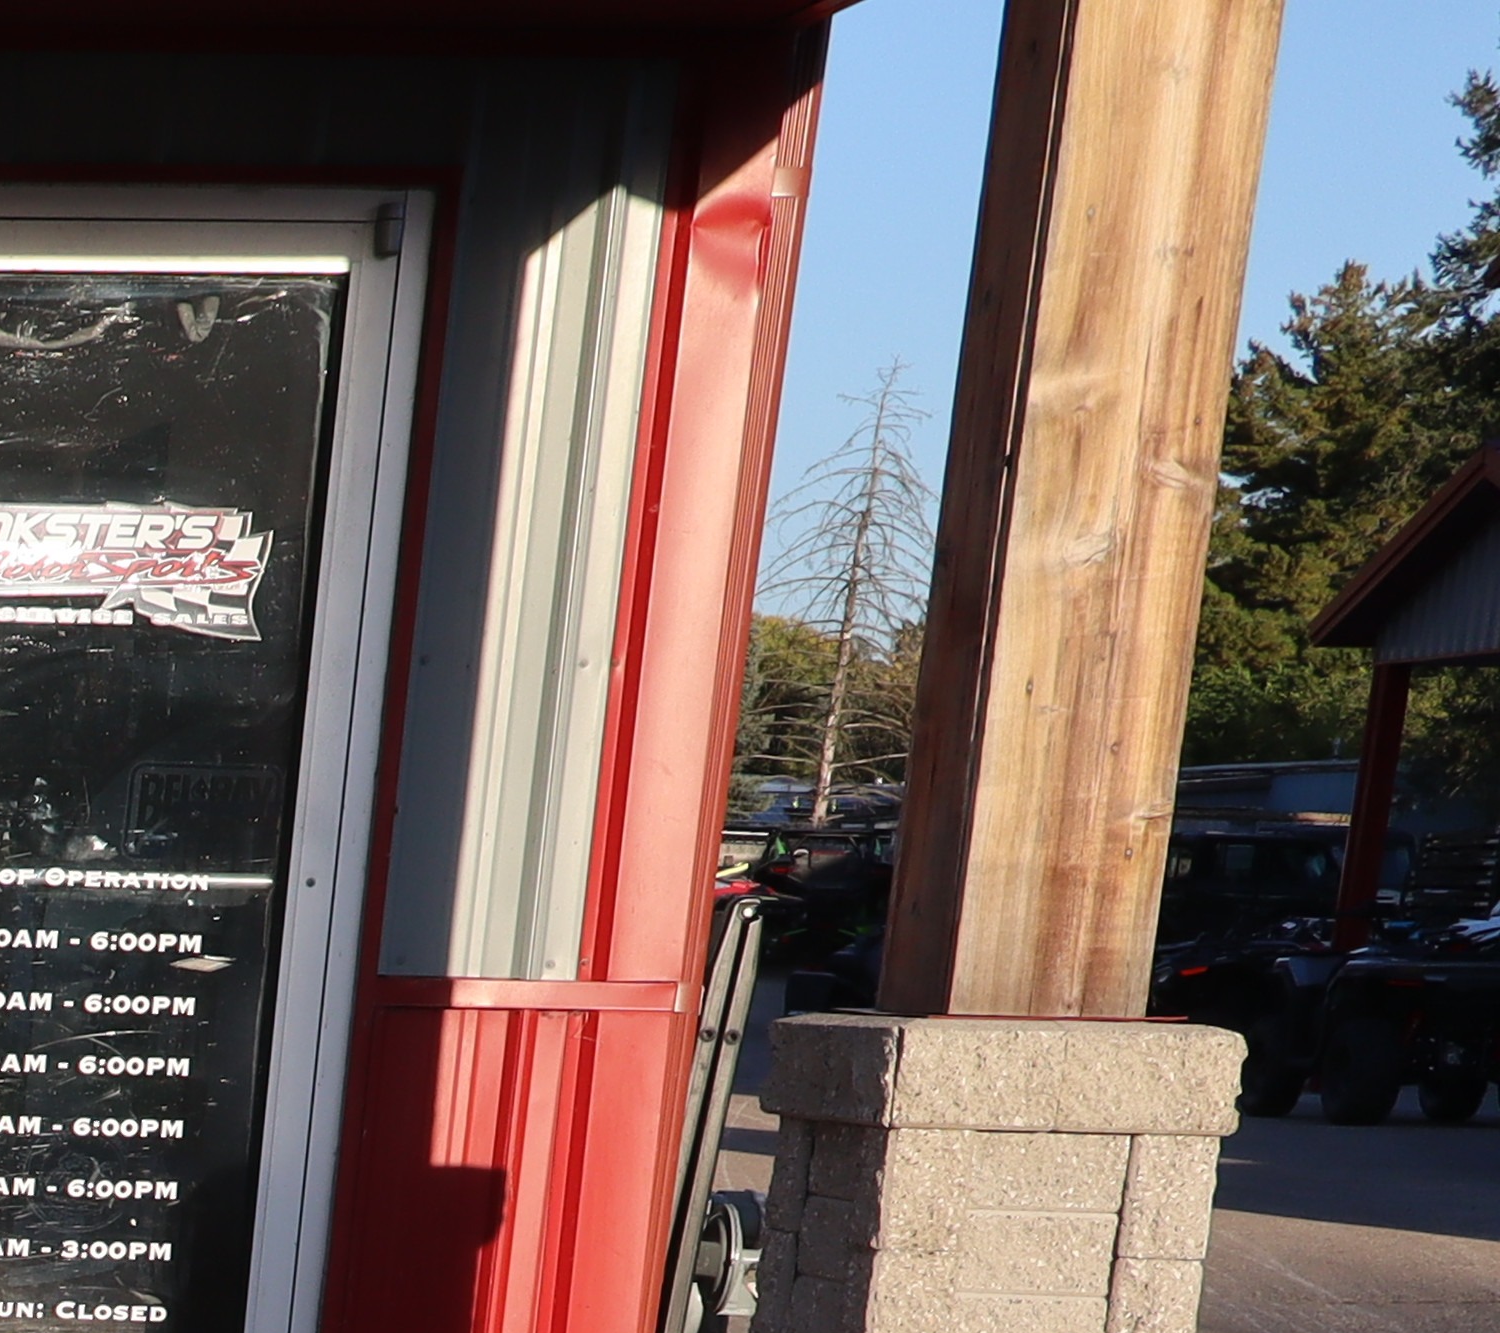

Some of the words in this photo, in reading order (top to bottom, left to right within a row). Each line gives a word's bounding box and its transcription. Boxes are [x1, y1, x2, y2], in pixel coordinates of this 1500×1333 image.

[149, 612, 249, 625] SALES
[90, 931, 202, 954] 6:00PM
[84, 993, 196, 1016] 6:00PM
[78, 1055, 190, 1077] 6:00PM
[72, 1117, 184, 1139] 6:00PM
[67, 1178, 178, 1200] 6:00PM
[60, 1239, 172, 1261] 3:00PM
